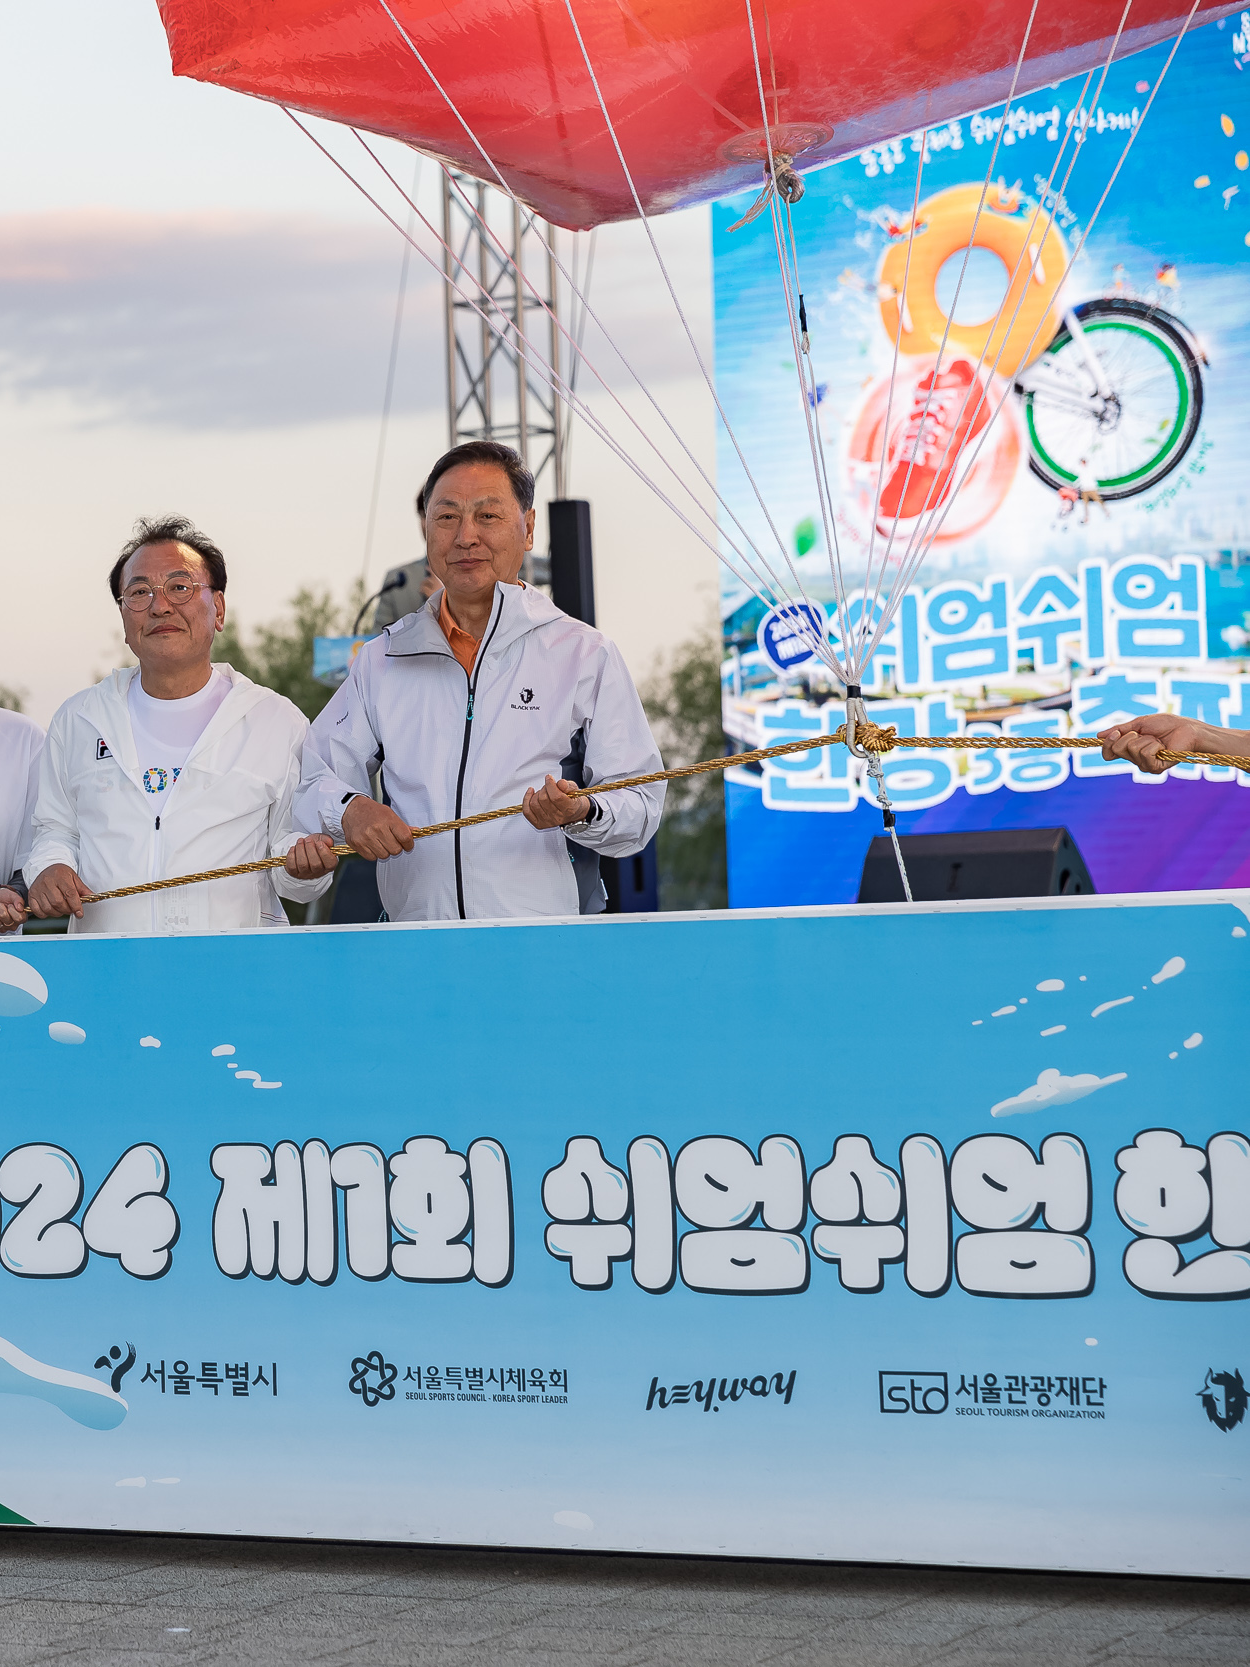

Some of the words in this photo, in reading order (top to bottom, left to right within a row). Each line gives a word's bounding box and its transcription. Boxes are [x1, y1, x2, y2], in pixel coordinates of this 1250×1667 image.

[812, 560, 1202, 690] 쉬엄쉬엄
[209, 1136, 515, 1289] 제1회
[540, 1132, 1096, 1300] 쉬엄쉬엄
[140, 1360, 278, 1397] 서울특별시
[402, 1365, 569, 1394] 서울특별시체육회
[955, 1372, 1108, 1407] 서울관광재단
[405, 1391, 428, 1402] SEOUL
[428, 1392, 456, 1402] SPORTS
[456, 1392, 487, 1402] COUNCIL
[492, 1394, 516, 1403] KOREA
[517, 1394, 541, 1404] SPORT
[541, 1394, 569, 1405] LEADER
[955, 1407, 985, 1417] SEOUL
[986, 1407, 1030, 1418] TOURISM
[1031, 1408, 1106, 1420] ORGANIZATION
